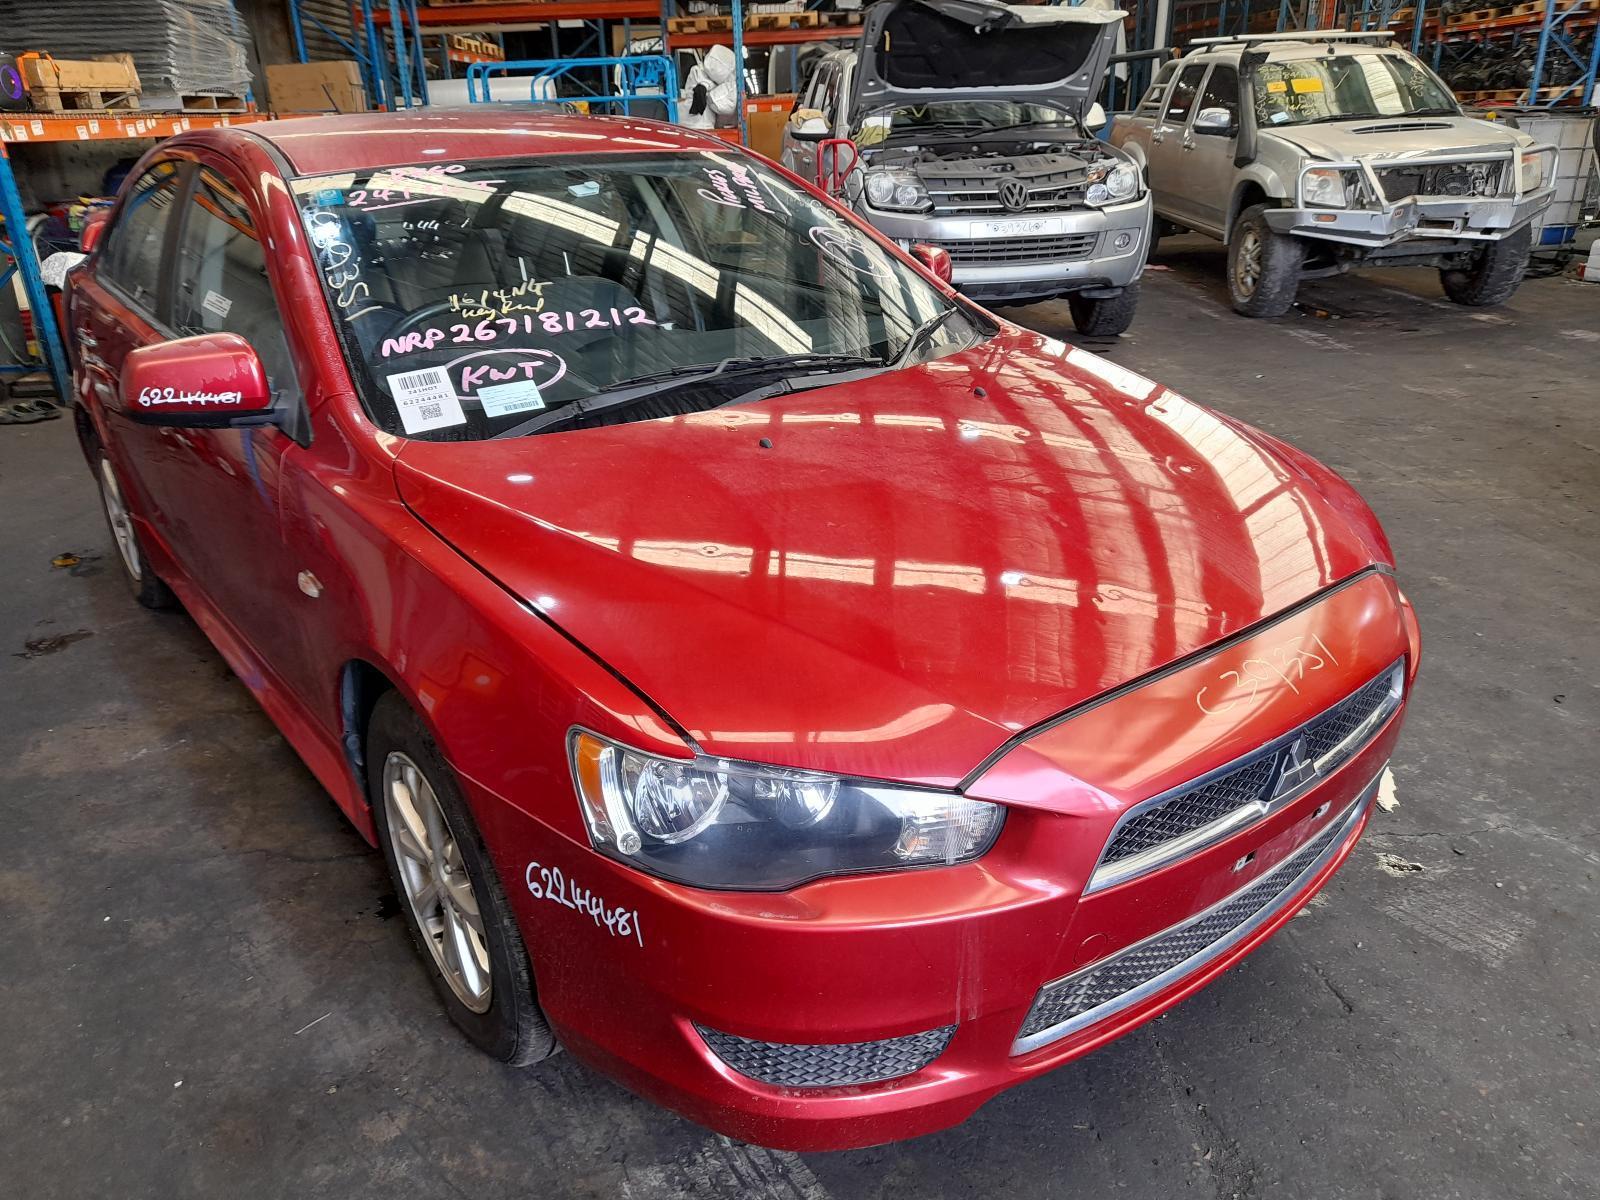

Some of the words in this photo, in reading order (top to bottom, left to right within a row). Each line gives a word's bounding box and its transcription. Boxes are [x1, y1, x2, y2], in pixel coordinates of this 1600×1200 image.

[449, 306, 657, 344] 267181212
[138, 386, 242, 407] 62244481
[525, 861, 644, 948] 62244481
